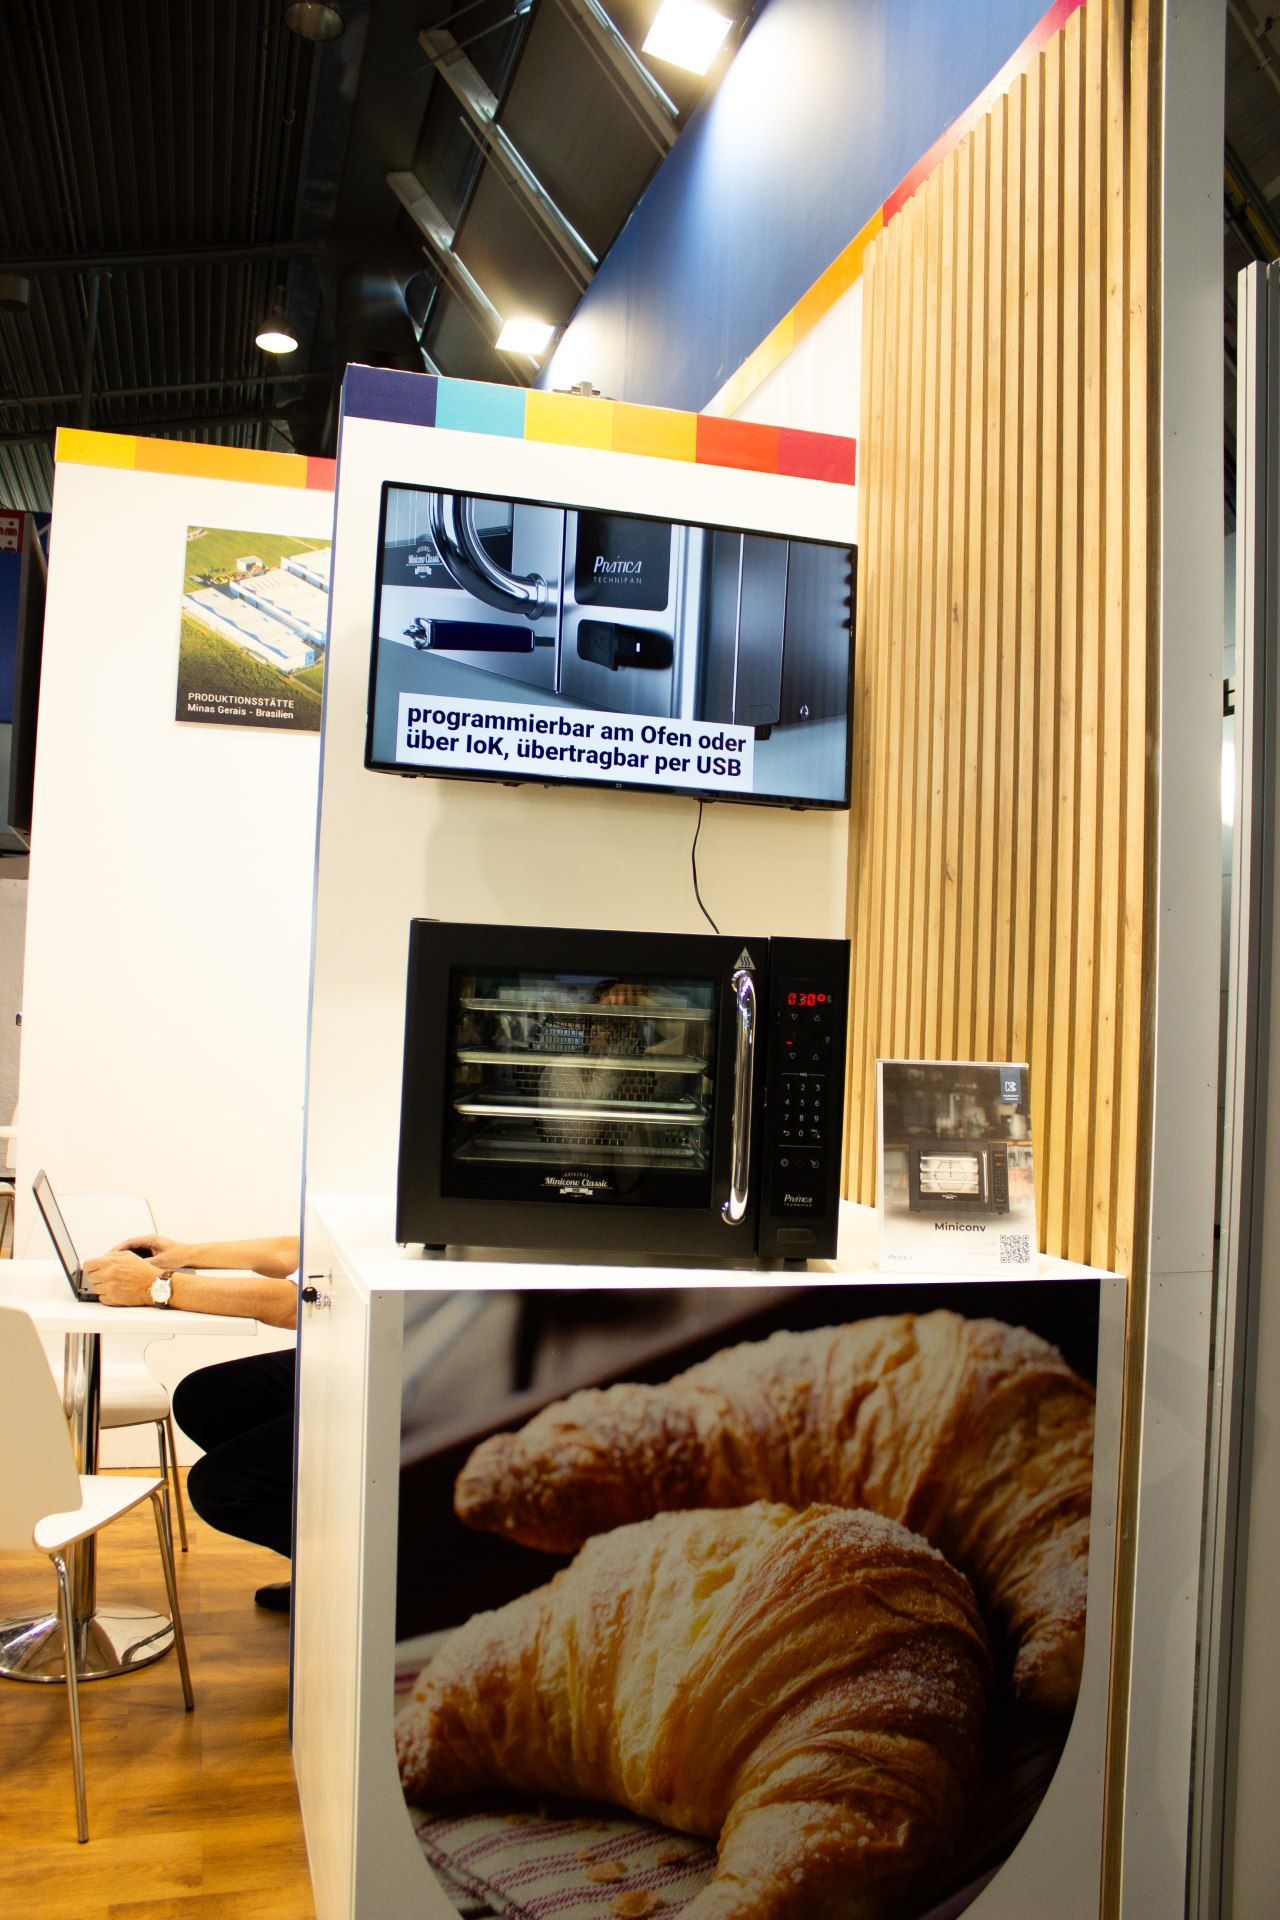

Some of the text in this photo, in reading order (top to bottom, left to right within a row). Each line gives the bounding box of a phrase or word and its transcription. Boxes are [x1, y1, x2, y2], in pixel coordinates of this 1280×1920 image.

[593, 576, 642, 584] TECHNIPAN
[188, 693, 294, 709] PRODUKTIONSSTÄTTE
[187, 703, 215, 714] Minas
[217, 705, 246, 716] Gerais
[256, 708, 294, 719] Brasilien
[407, 707, 747, 752] programmierbar am Ofen oder
[406, 729, 741, 777] über IoK, übertragbar per USB
[815, 1084, 821, 1092] 3
[799, 1114, 804, 1122] 8
[544, 1176, 608, 1187] Miniconv Classic
[934, 1222, 987, 1232] Miniconv
